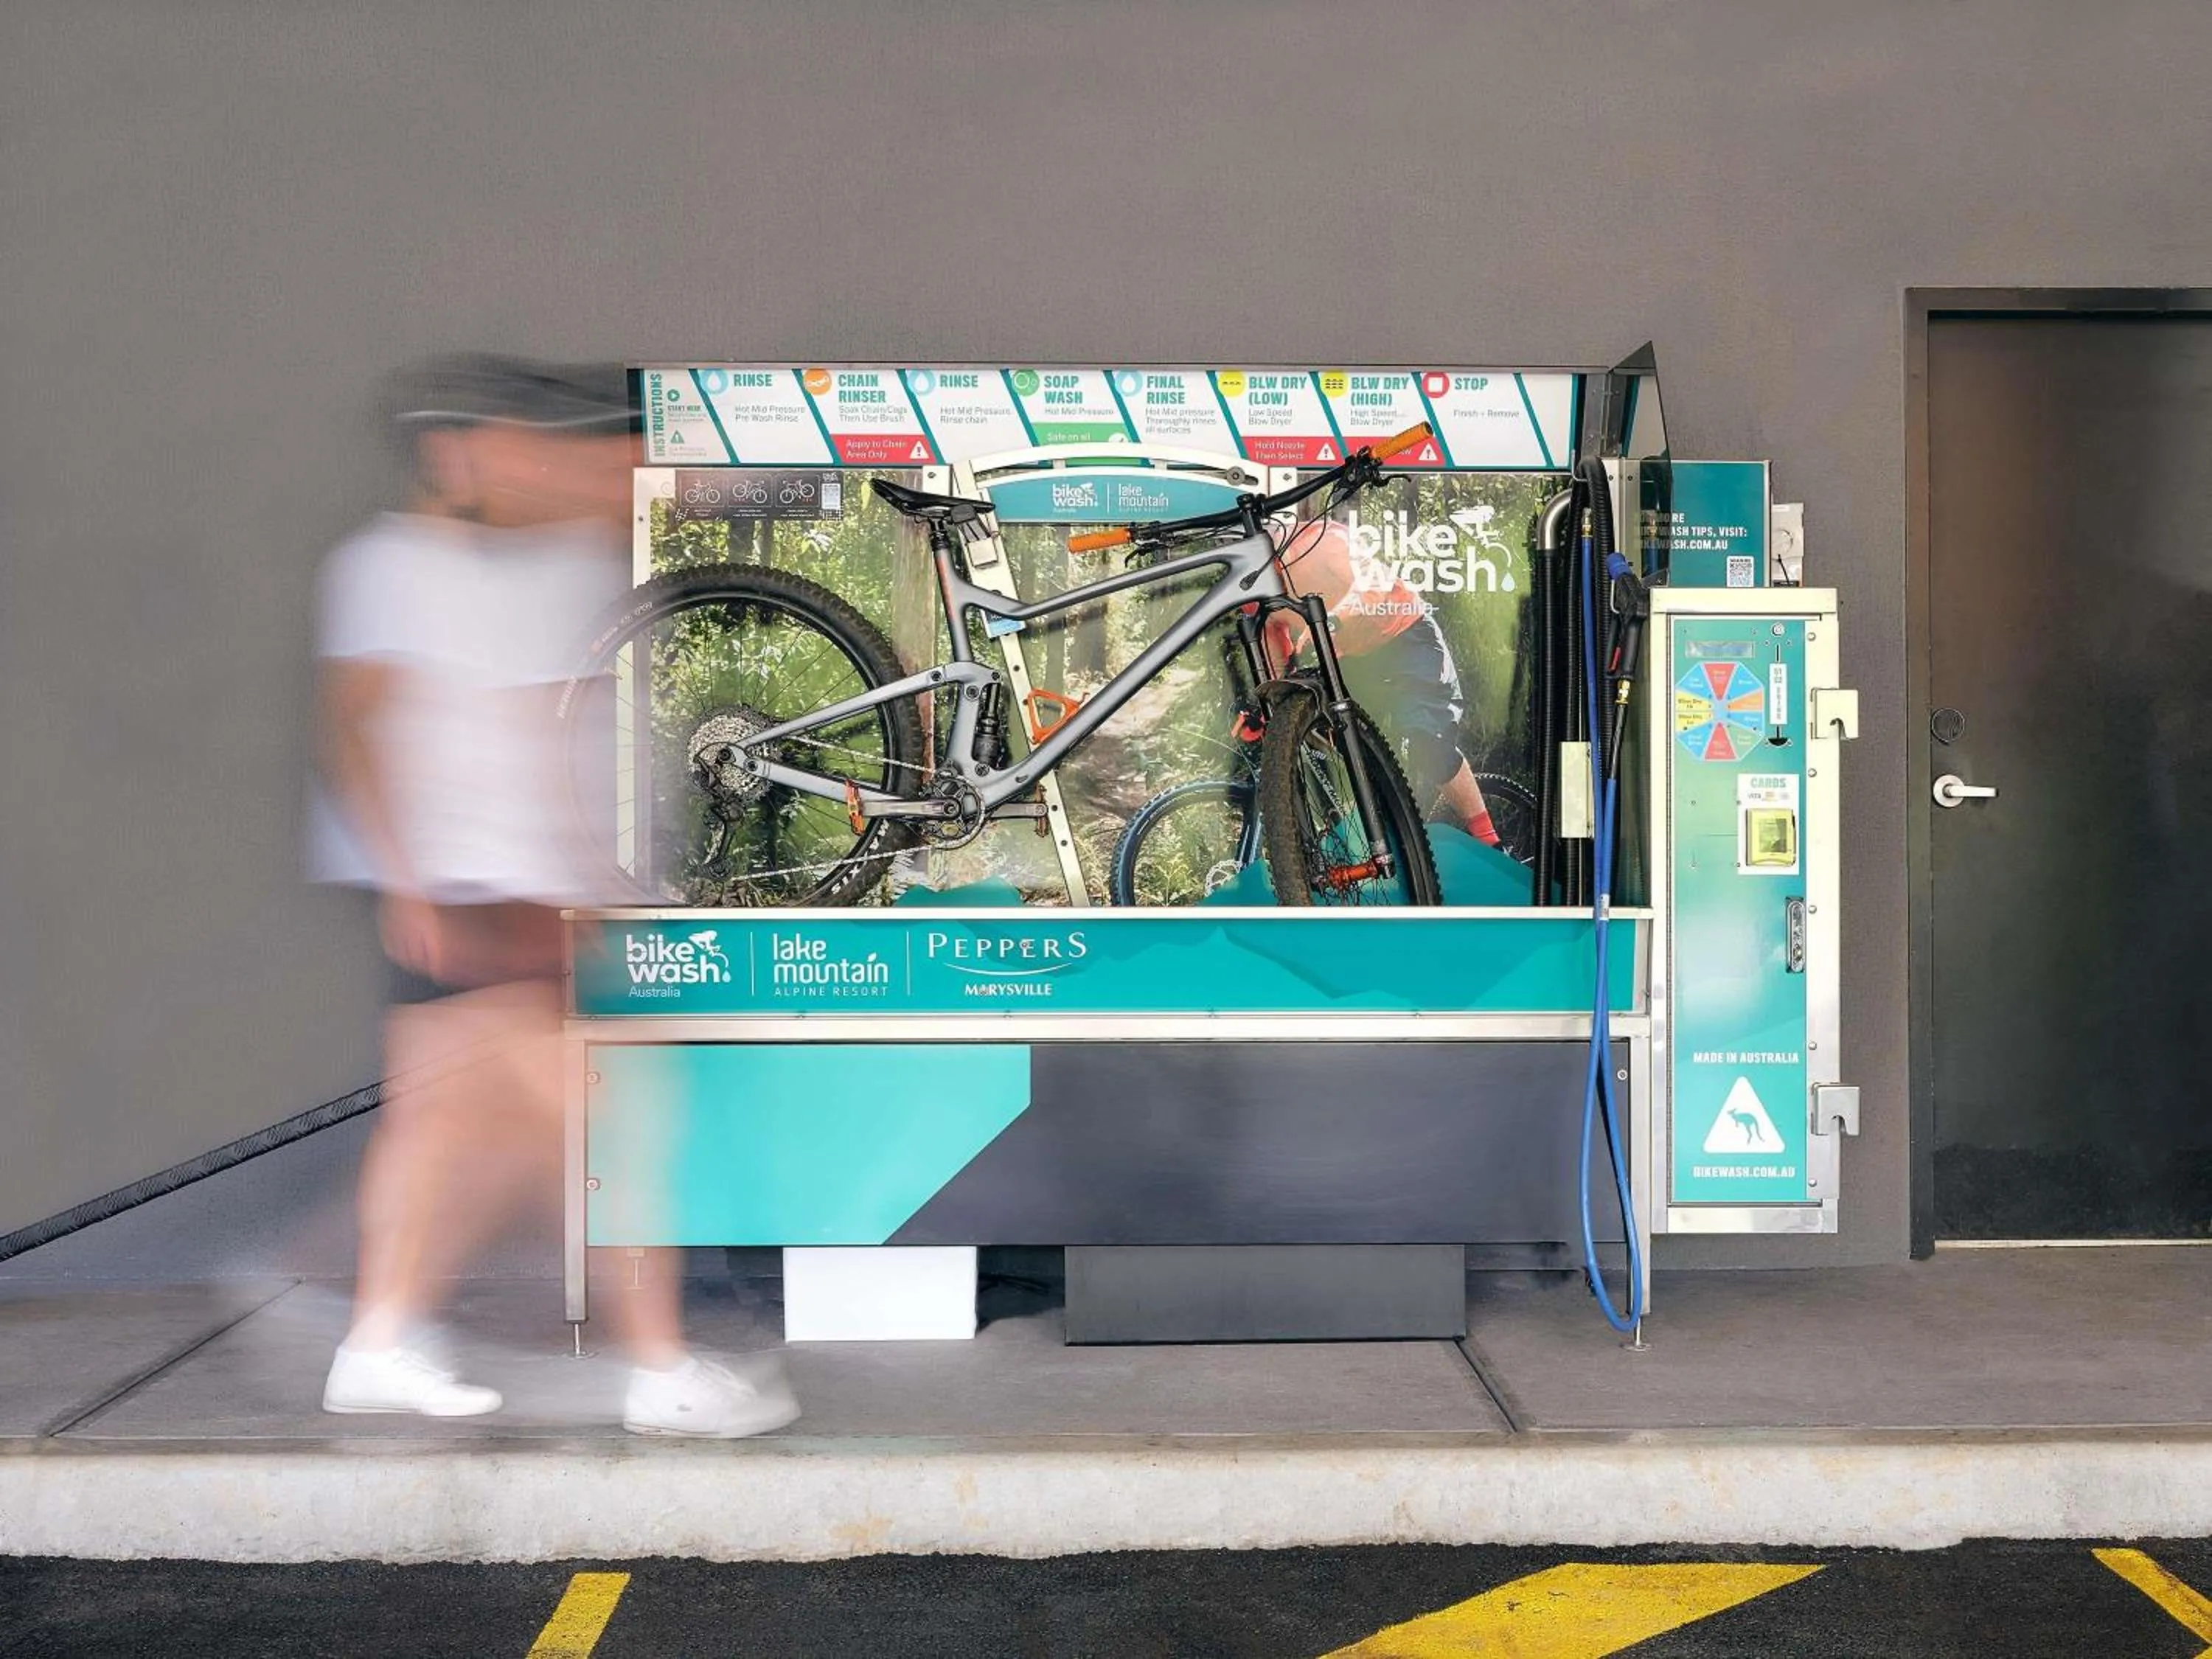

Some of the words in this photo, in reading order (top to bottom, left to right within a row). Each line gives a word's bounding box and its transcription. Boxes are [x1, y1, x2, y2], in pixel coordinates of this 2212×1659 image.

[734, 374, 773, 387] RINSE
[838, 374, 878, 387] CHAIN
[939, 375, 978, 388] RINSE
[1044, 375, 1079, 388] SOAP
[1147, 375, 1185, 389] FINAL
[1249, 377, 1279, 389] BLW
[1281, 377, 1307, 389] DRY
[1351, 377, 1380, 390] BLW
[1383, 377, 1409, 390] DRY
[1455, 377, 1489, 390] STOP
[838, 390, 886, 403] RINSER
[1045, 392, 1082, 404] WASH
[1147, 392, 1185, 404] RINSE
[1248, 392, 1288, 406] (LOW)
[1350, 393, 1393, 406] (HIGH)
[650, 373, 666, 456] INSTRUCTIONS
[940, 407, 954, 415] Hot
[957, 407, 973, 415] Mid
[1045, 407, 1060, 415] Hot
[1145, 408, 1159, 416] Hot
[1249, 408, 1265, 417] Low
[1266, 408, 1293, 418] Speed
[1350, 409, 1368, 418] High
[1453, 410, 1476, 418] Finish
[1487, 410, 1520, 418] Remove
[735, 414, 749, 422] Pre
[751, 414, 773, 422] Wash
[839, 414, 860, 422] Then
[862, 414, 878, 422] Use
[880, 414, 905, 422] Brush
[940, 416, 963, 424] Rinse
[964, 416, 987, 424] chain
[1270, 417, 1292, 427] Dryer
[1372, 418, 1394, 428] Dryer
[1047, 433, 1066, 441] Safe
[846, 439, 870, 449] Apply
[846, 451, 866, 459] Area
[1053, 483, 1083, 498] bike
[1119, 483, 1142, 496] lake
[1053, 494, 1094, 507] wash
[1119, 493, 1169, 507] mountain
[1349, 509, 1458, 558] bike
[1692, 526, 1717, 538] TIPS,
[1719, 526, 1747, 537] VISIT:
[1349, 546, 1497, 592] wash
[1350, 599, 1433, 616] Australia
[1750, 777, 1787, 788] CARDS
[627, 934, 695, 962] bike
[773, 933, 827, 960] lake
[627, 955, 720, 983] wash
[774, 952, 888, 984] mountain
[628, 986, 681, 998] Australia
[774, 987, 826, 996] ALPINE
[832, 987, 888, 996] RESORT
[1694, 1052, 1723, 1063] MADE
[1726, 1052, 1737, 1063] IN
[1740, 1052, 1798, 1063] AUSTRALIA
[1693, 1166, 1795, 1178] BIKEWASH.COM.AU
